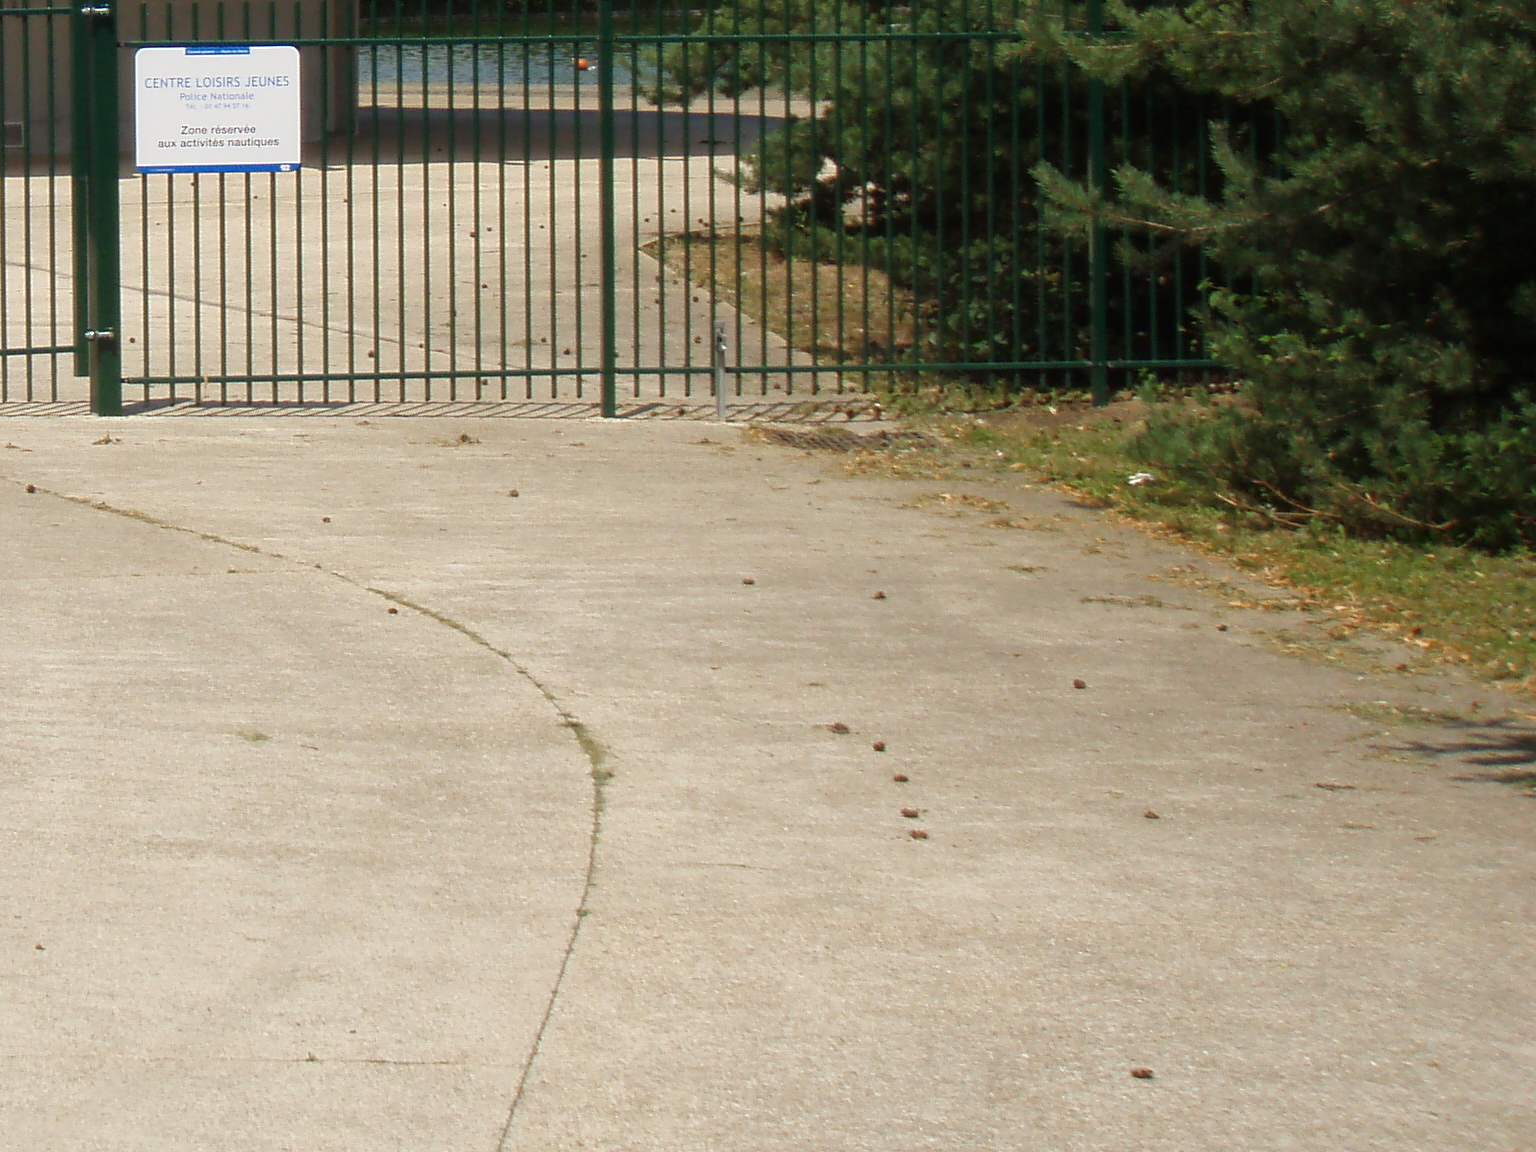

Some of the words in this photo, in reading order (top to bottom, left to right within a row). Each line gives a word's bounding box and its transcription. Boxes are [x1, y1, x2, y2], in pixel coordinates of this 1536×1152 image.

[145, 77, 191, 89] CENTRE
[196, 76, 240, 88] LOISIRS
[245, 75, 290, 87] JEUNES
[180, 92, 207, 100] Police
[211, 91, 255, 100] Nationale
[181, 125, 207, 135] Zone
[211, 124, 256, 134] réservée
[158, 140, 177, 148] aux
[180, 138, 224, 148] activités
[228, 137, 280, 148] nautiques
